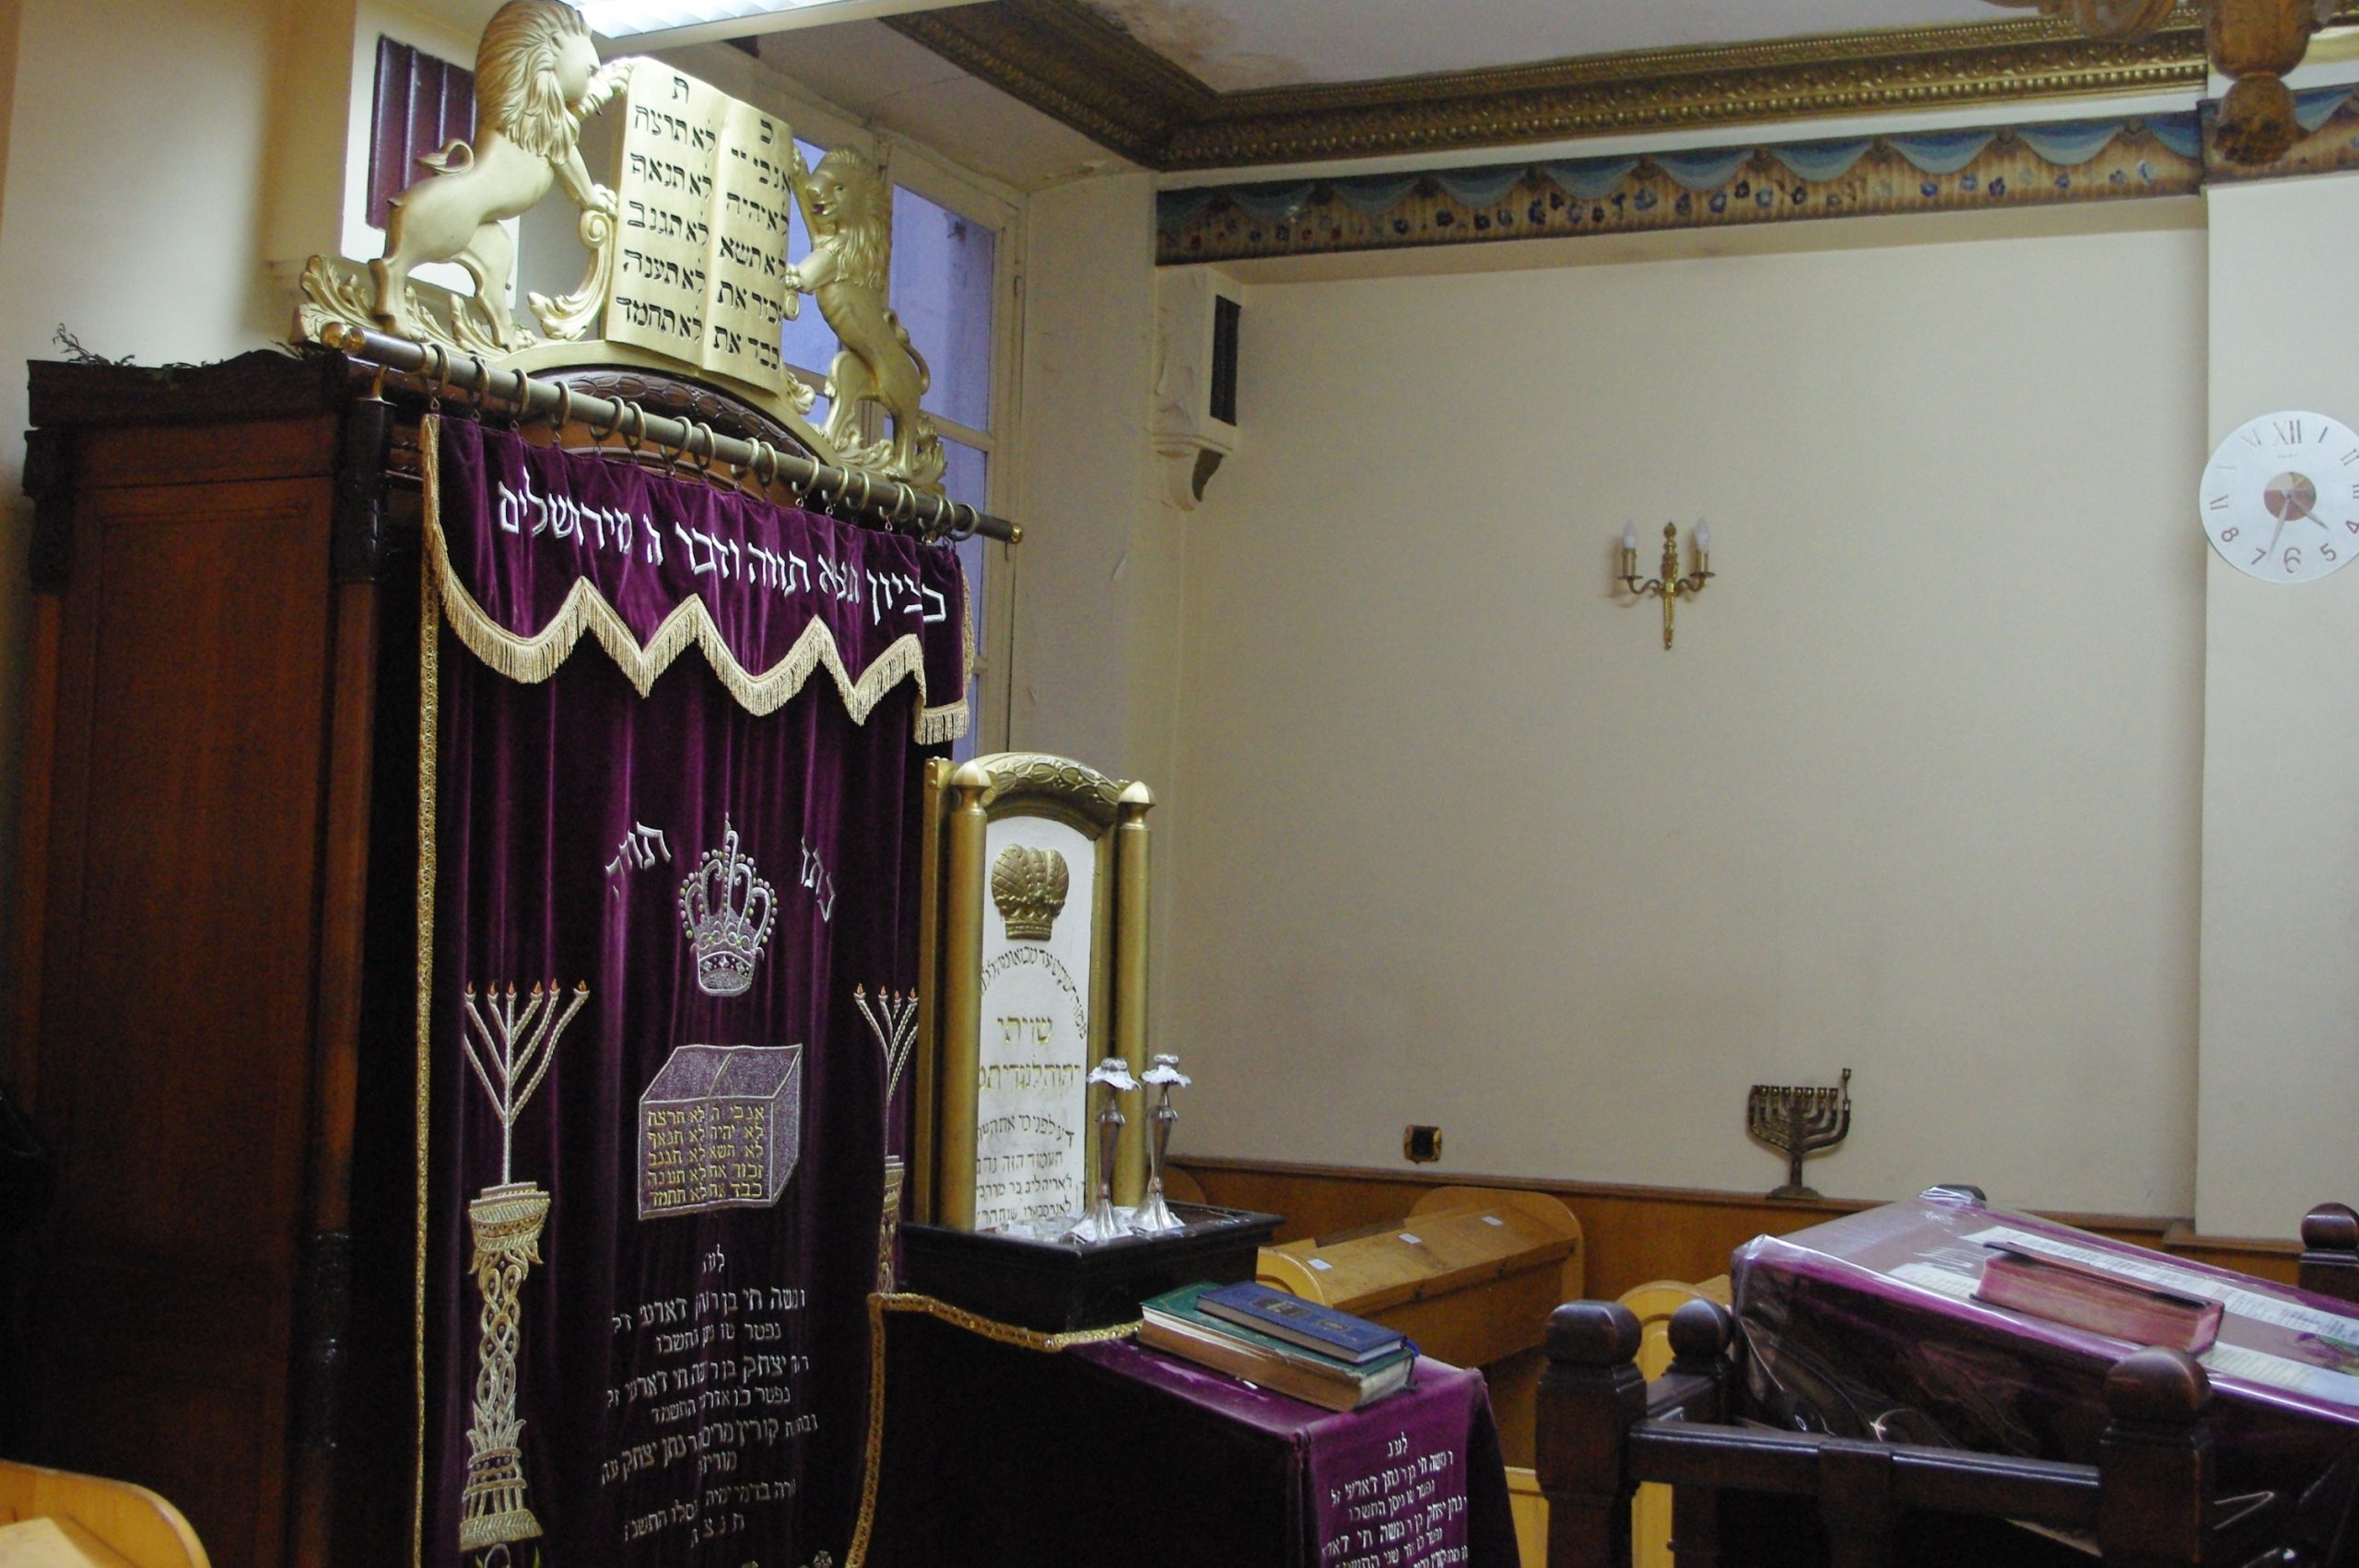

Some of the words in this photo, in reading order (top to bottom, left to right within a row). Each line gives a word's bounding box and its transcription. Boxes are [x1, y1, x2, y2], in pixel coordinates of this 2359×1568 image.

[692, 120, 716, 154] לא
[689, 163, 712, 200] לא
[686, 211, 709, 247] לא
[719, 235, 761, 269] תשא
[682, 258, 706, 295] לא
[717, 280, 747, 311] את
[679, 306, 702, 343] לא
[712, 325, 742, 355] את
